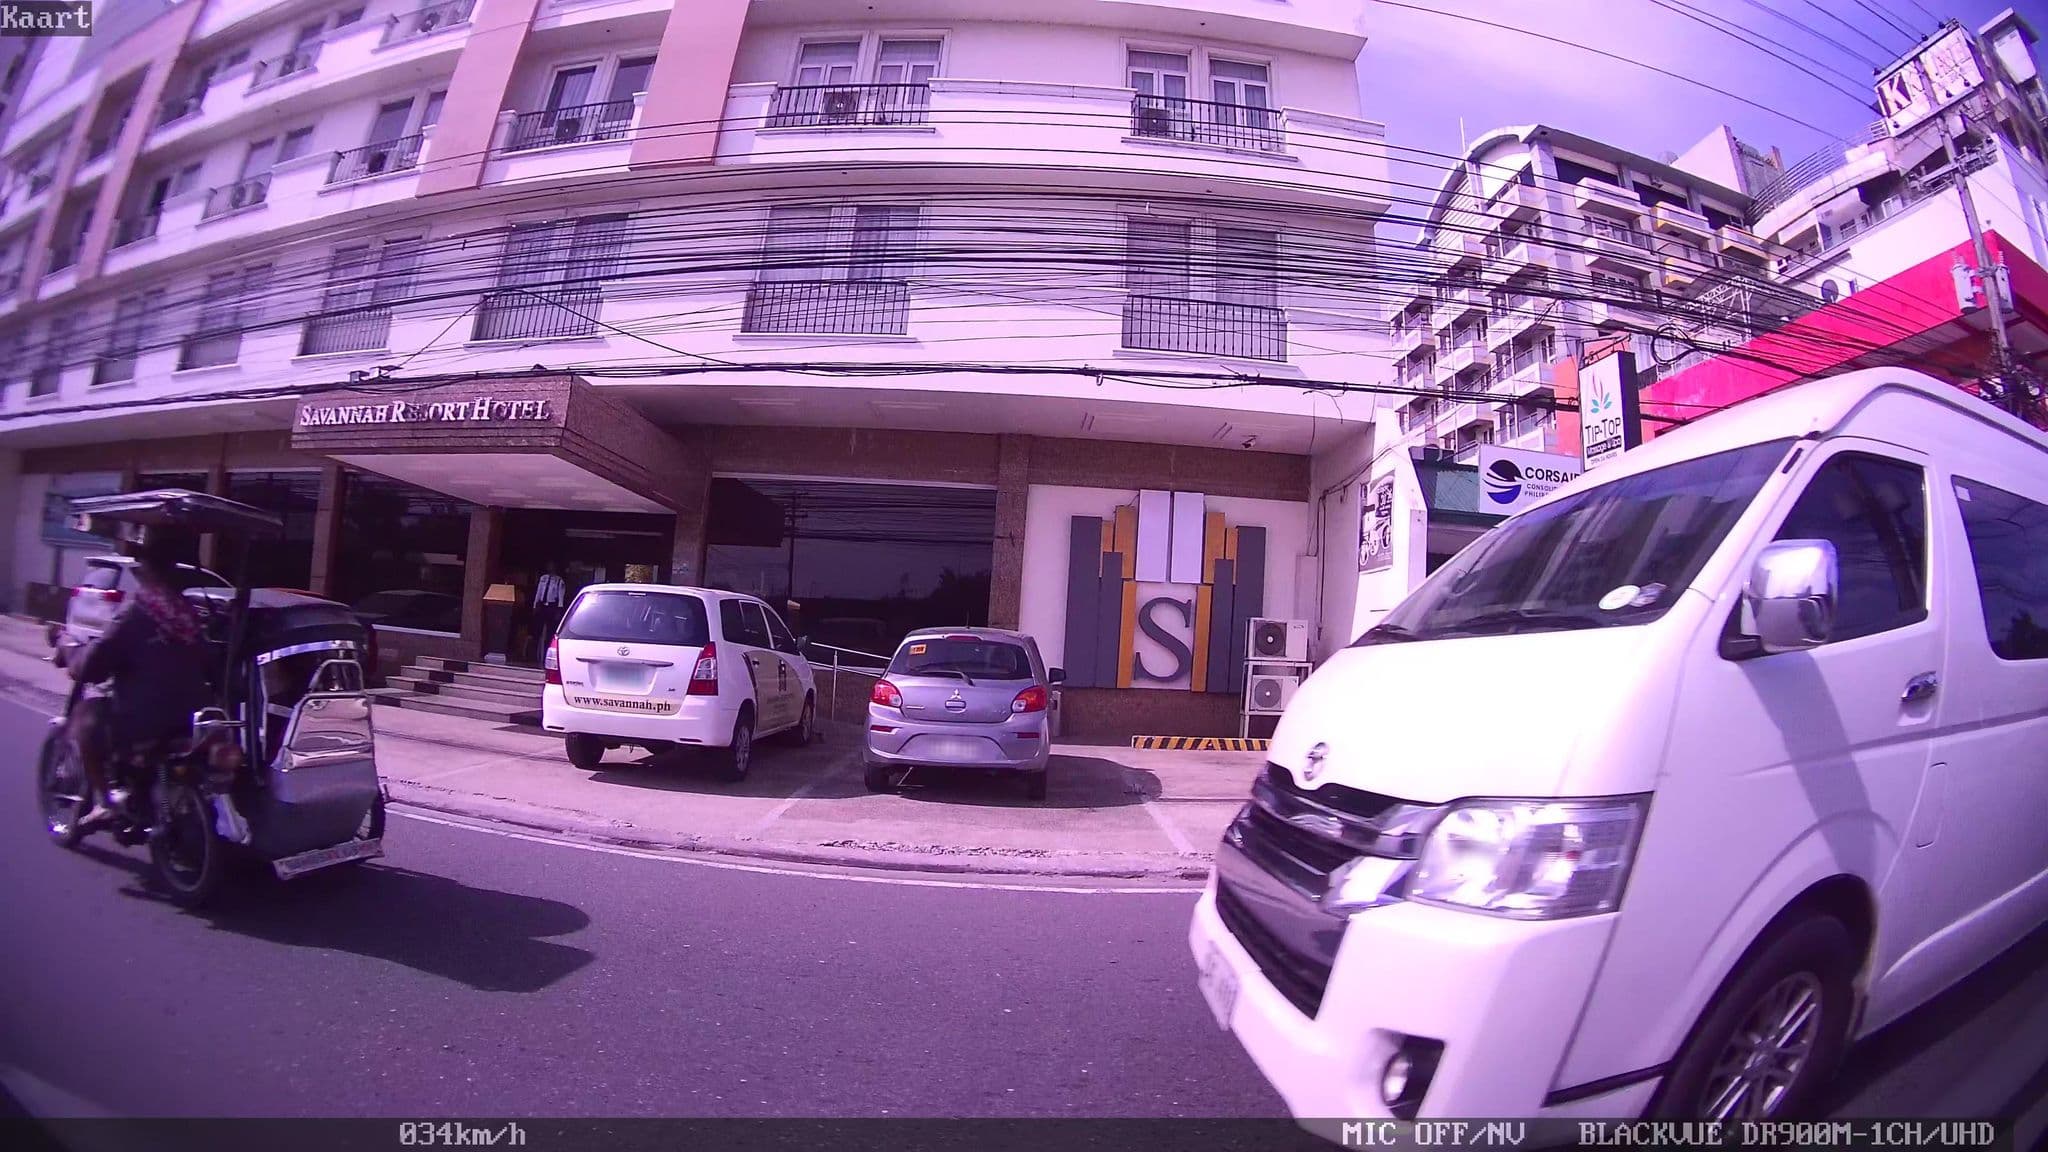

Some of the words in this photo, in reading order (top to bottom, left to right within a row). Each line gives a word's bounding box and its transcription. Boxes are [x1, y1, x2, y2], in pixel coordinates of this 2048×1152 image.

[299, 405, 390, 426] SAVANNAH
[470, 396, 549, 421] HOTEL
[1585, 417, 1621, 444] TIP-TOP
[1134, 596, 1193, 682] S
[574, 695, 671, 713] www.savannah.ph
